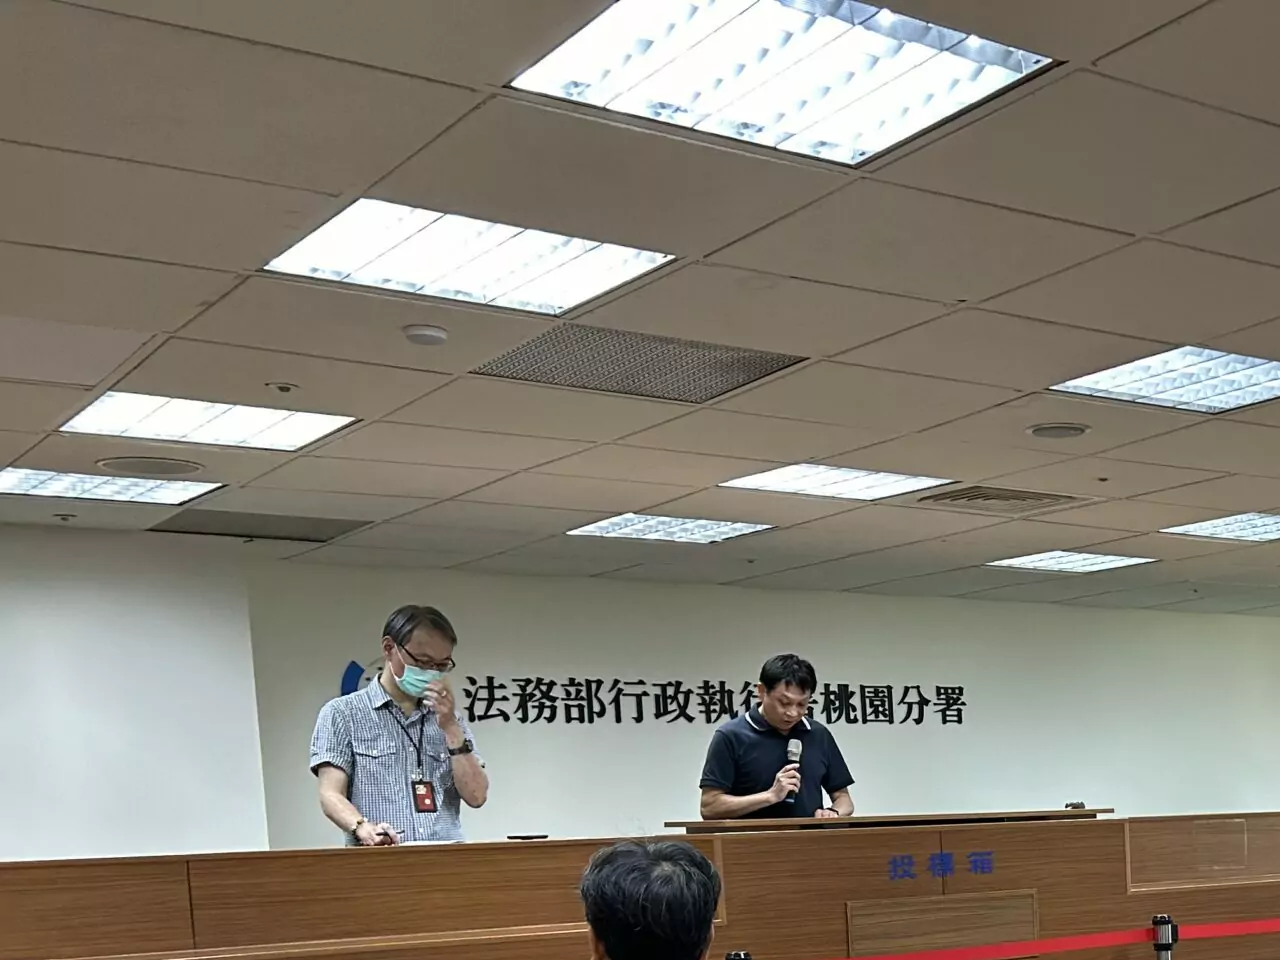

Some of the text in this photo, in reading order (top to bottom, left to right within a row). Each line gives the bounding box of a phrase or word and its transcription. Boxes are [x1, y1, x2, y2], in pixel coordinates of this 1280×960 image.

[462, 675, 968, 726] 法務部行政執桃園分署
[888, 851, 994, 881] 投標箱
